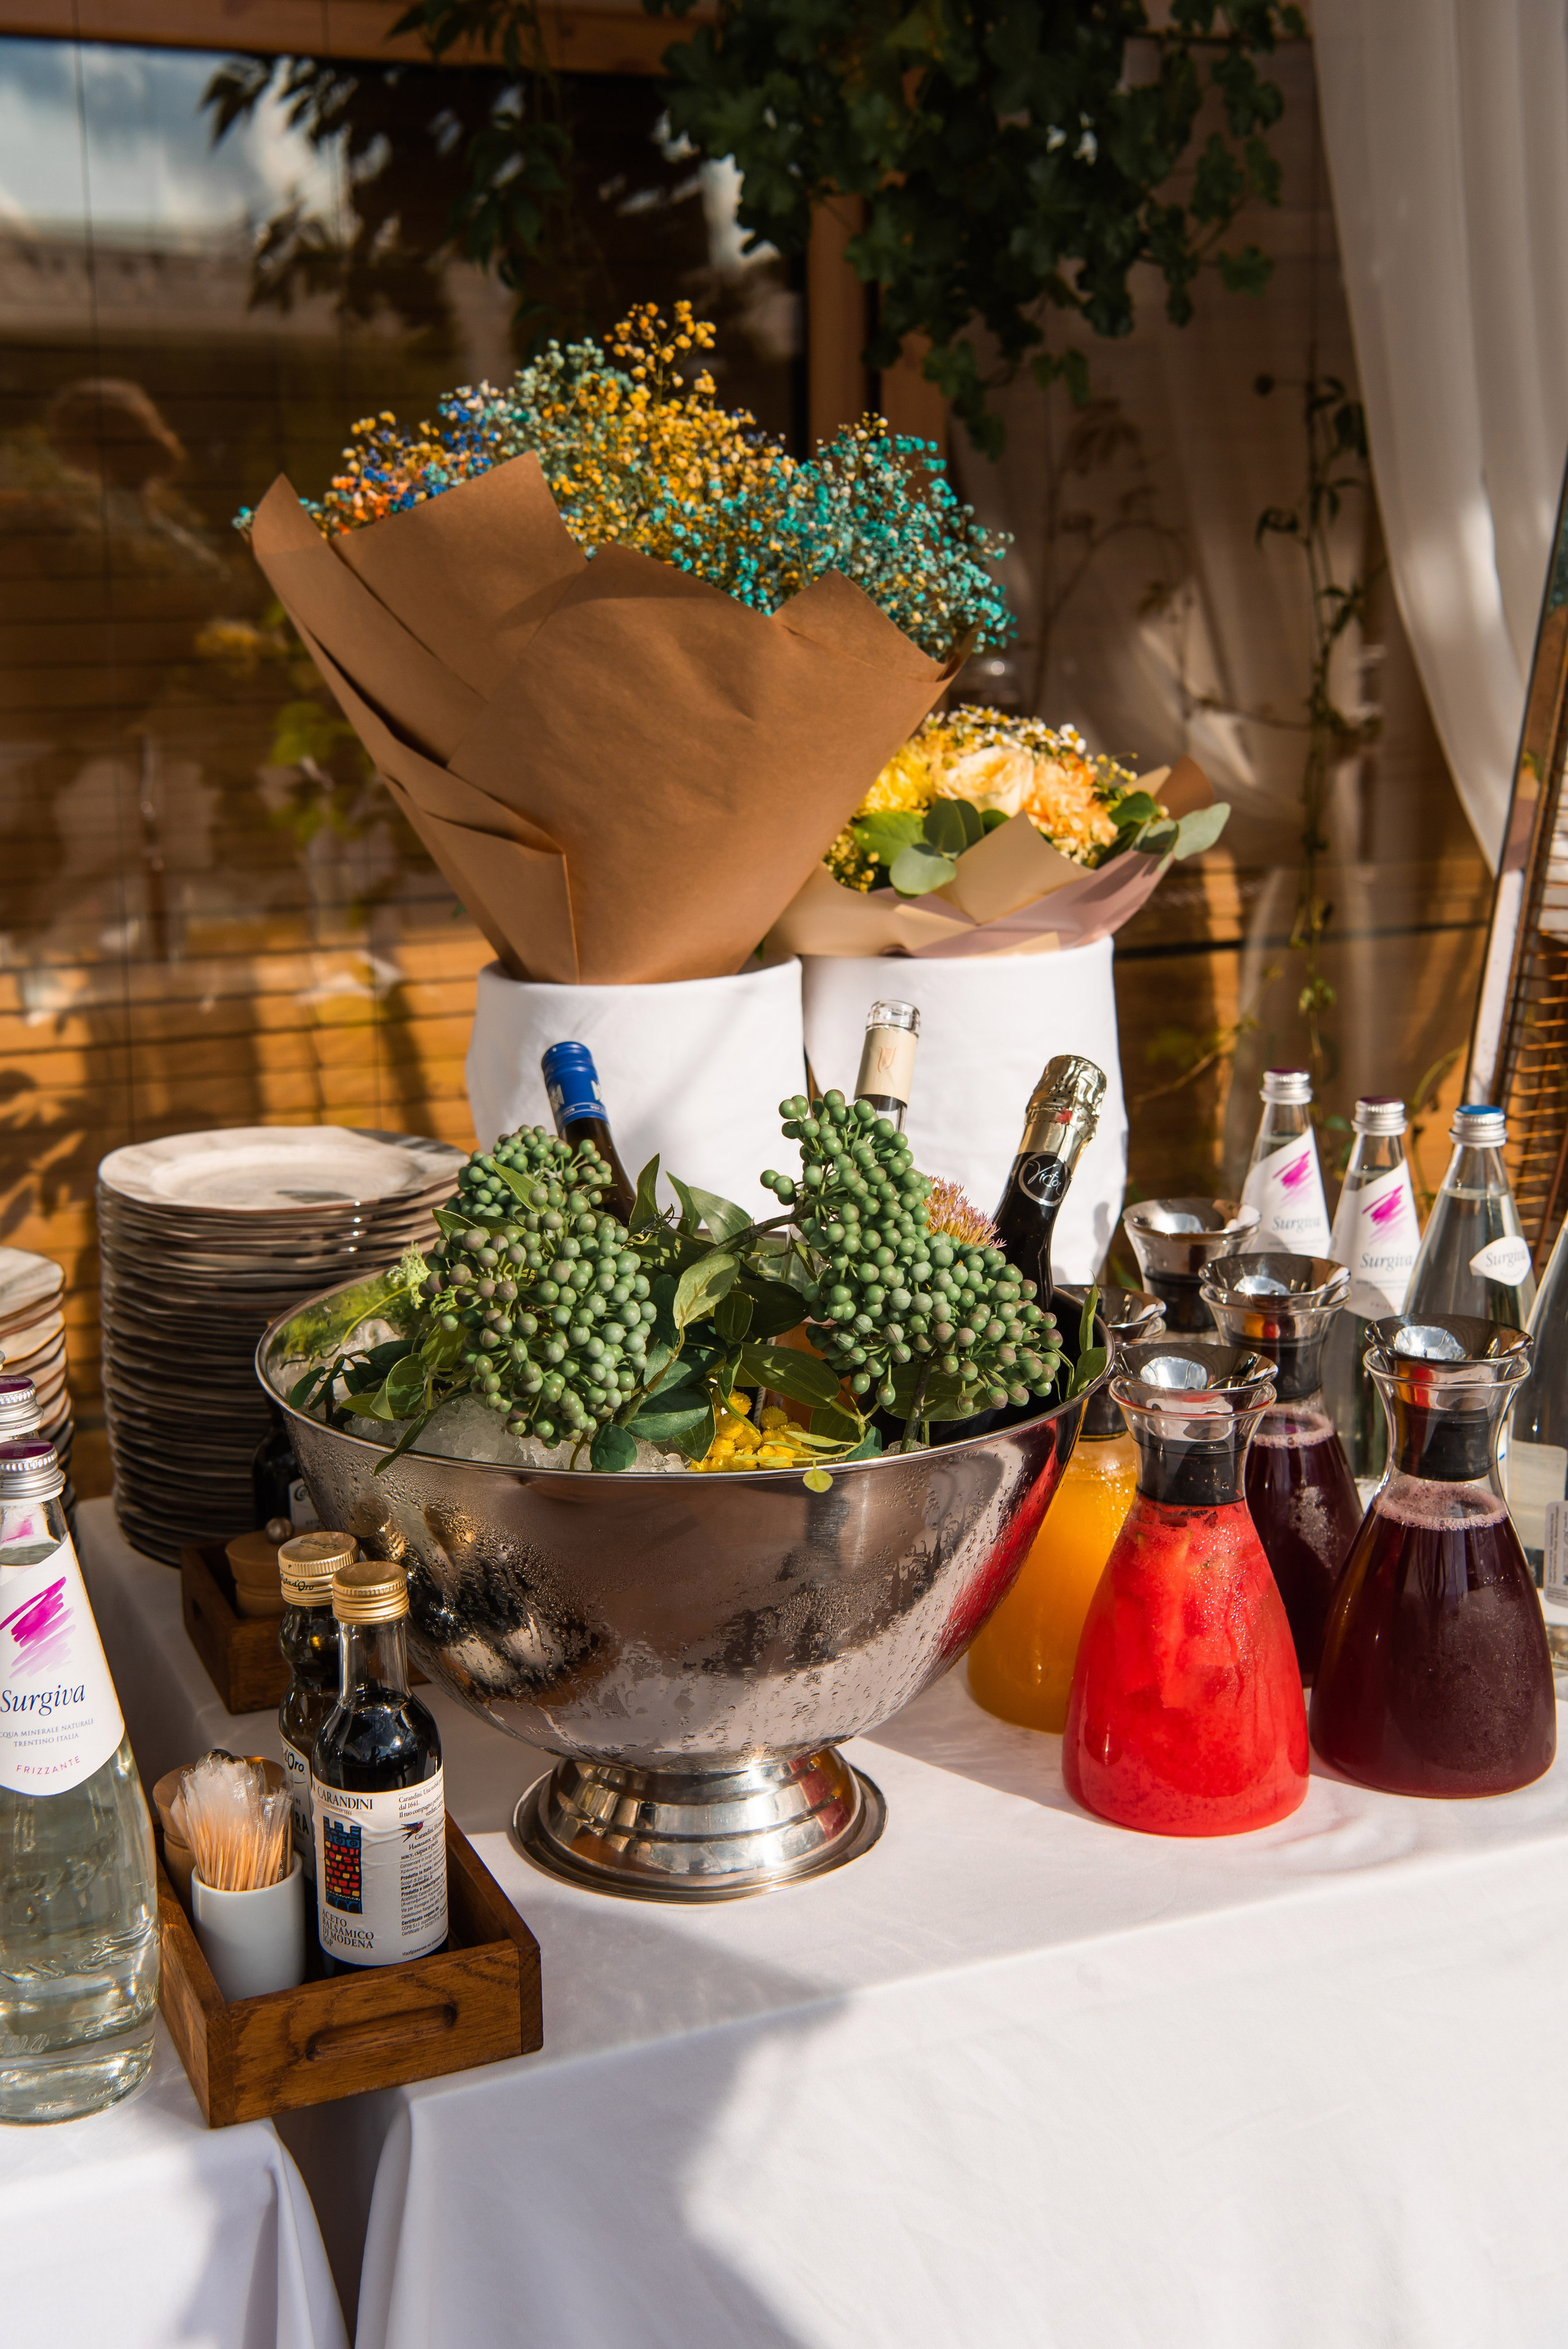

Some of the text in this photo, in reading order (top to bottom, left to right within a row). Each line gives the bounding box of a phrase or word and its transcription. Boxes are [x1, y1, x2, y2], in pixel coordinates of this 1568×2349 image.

[1028, 1159, 1061, 1196] Victor
[0, 1684, 85, 1716] Surgiva
[21, 1726, 59, 1737] MINERALE
[61, 1718, 94, 1731] NATURALE
[13, 1733, 79, 1748] TRENTINO ITALIA
[17, 1756, 80, 1774] FRIZZANTE
[317, 1786, 373, 1810] CARANDINI
[399, 1791, 423, 1803] Carandini.
[407, 1800, 420, 1809] 1641.
[412, 1803, 432, 1814] compagno
[322, 1909, 347, 1927] ACETO
[402, 1916, 423, 1925] Certificato
[323, 1917, 374, 1940] BALSAMICO
[323, 1925, 373, 1948] DI MODENA
[323, 1933, 333, 1947] IGP
